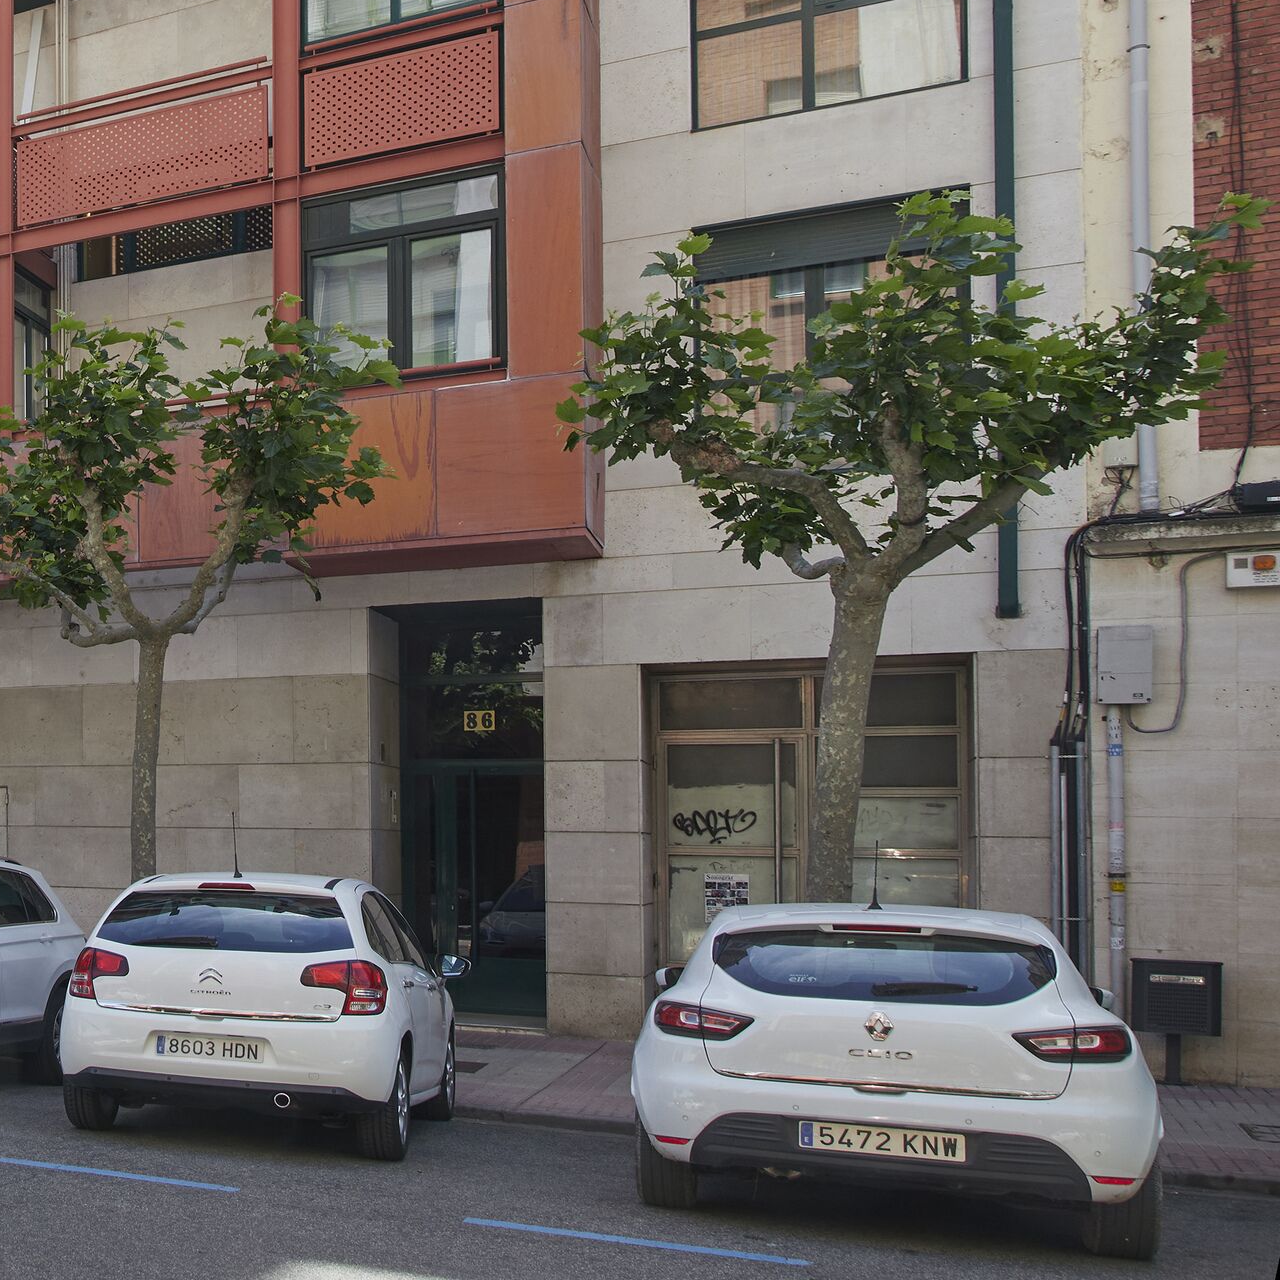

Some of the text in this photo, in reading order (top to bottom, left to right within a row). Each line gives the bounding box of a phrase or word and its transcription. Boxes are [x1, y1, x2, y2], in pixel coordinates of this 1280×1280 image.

[466, 712, 493, 729] 86
[169, 1038, 215, 1056] 8603
[222, 1042, 258, 1060] HDN
[848, 1049, 913, 1060] CLIO
[819, 1126, 891, 1152] 5472
[903, 1133, 957, 1158] KNW
